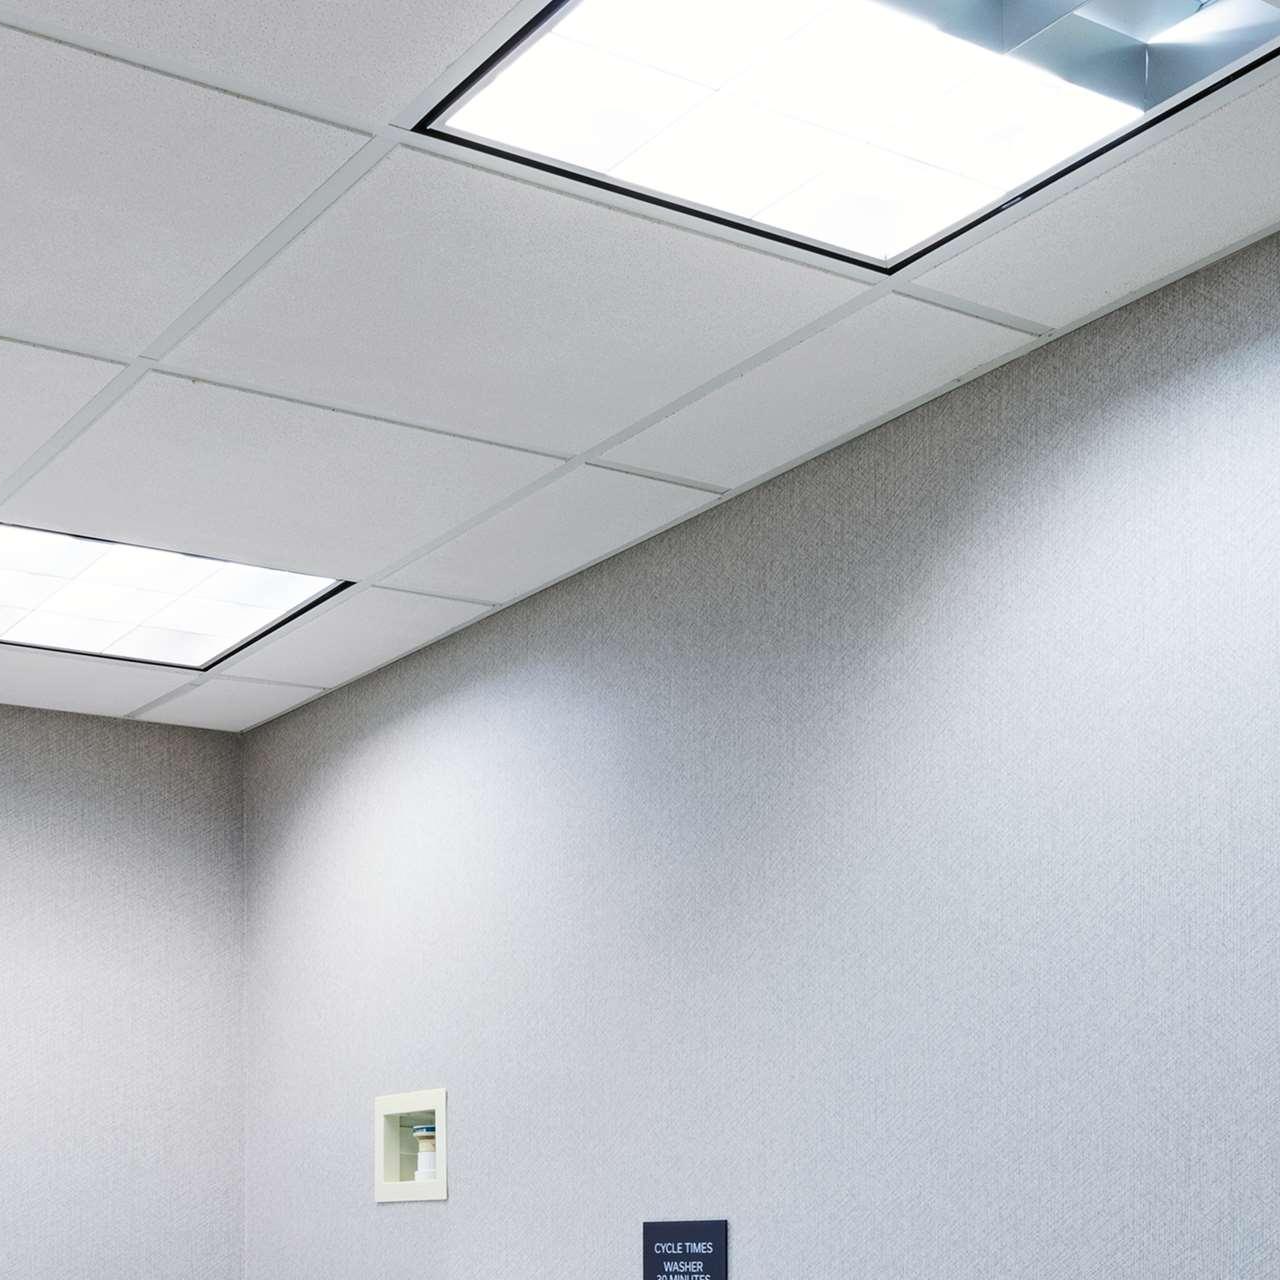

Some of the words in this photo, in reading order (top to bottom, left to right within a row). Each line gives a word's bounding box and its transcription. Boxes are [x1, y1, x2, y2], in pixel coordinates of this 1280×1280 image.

[654, 1243, 683, 1253] CYCLE
[685, 1242, 713, 1253] TIMES
[663, 1261, 704, 1272] WASHER
